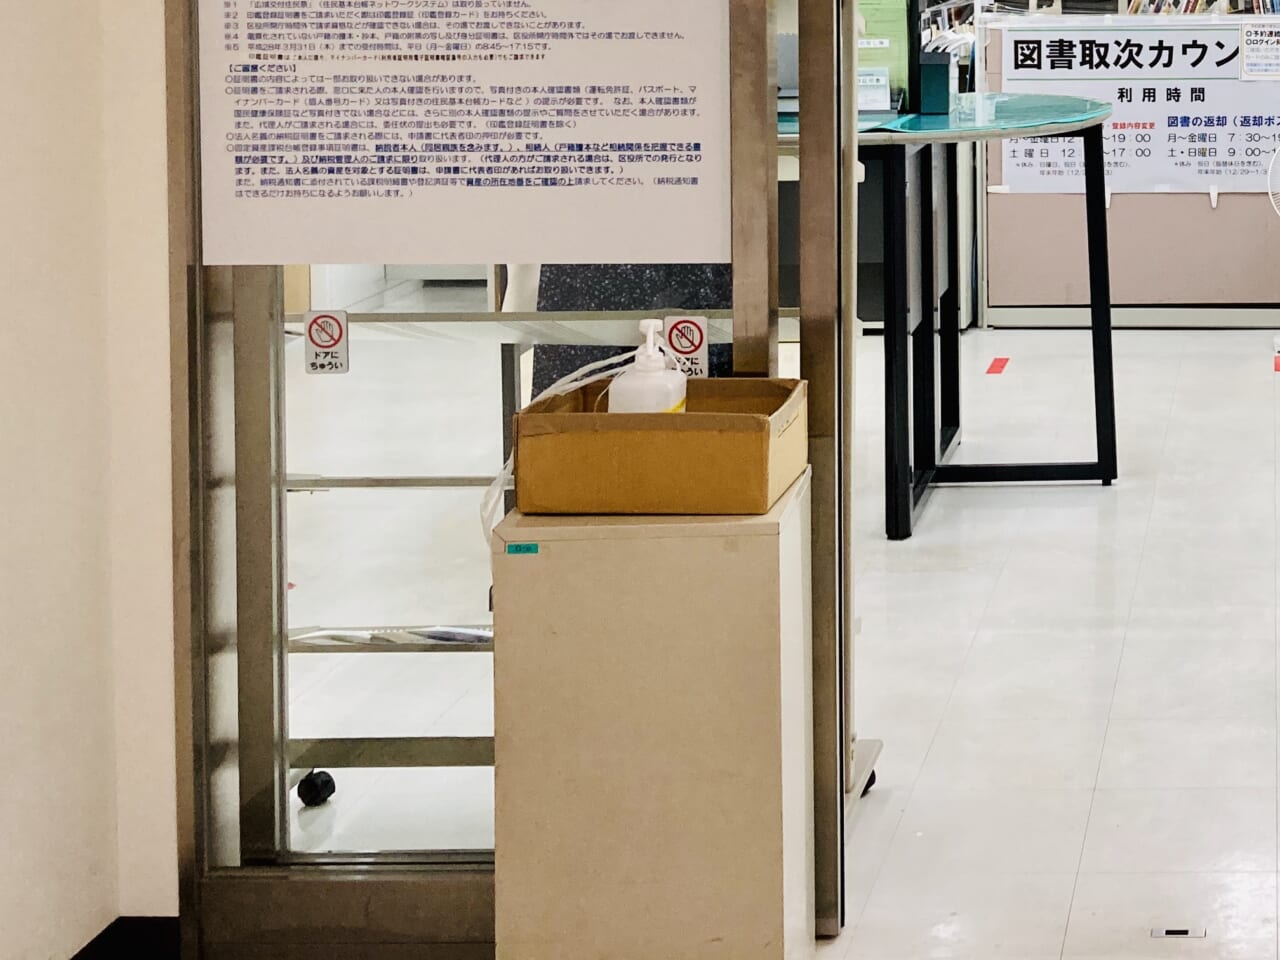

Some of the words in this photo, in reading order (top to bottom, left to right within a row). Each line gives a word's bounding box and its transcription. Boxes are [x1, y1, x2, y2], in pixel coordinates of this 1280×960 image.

[1013, 38, 1240, 70] 図書取次カウン
[313, 350, 340, 360] ドアに
[310, 361, 345, 372] ちゅうい
